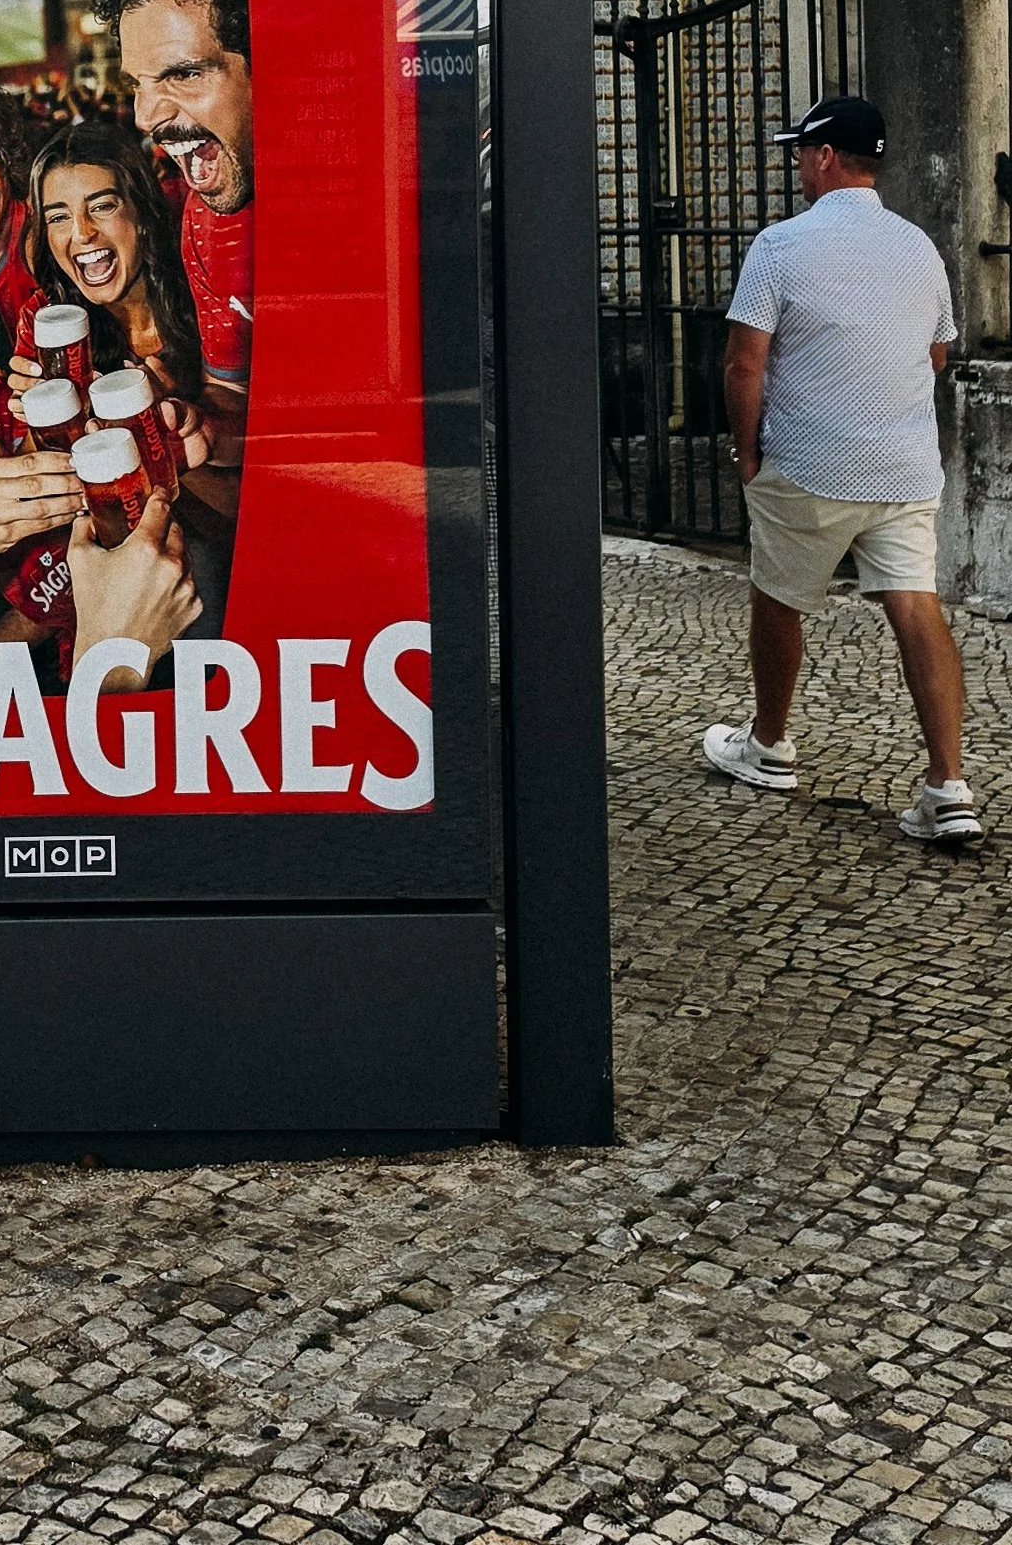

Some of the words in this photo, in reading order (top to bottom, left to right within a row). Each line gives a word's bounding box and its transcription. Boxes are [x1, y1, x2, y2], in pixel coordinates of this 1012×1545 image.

[139, 408, 165, 461] SAGRES
[30, 562, 71, 613] SAGR
[12, 846, 106, 867] MOP
